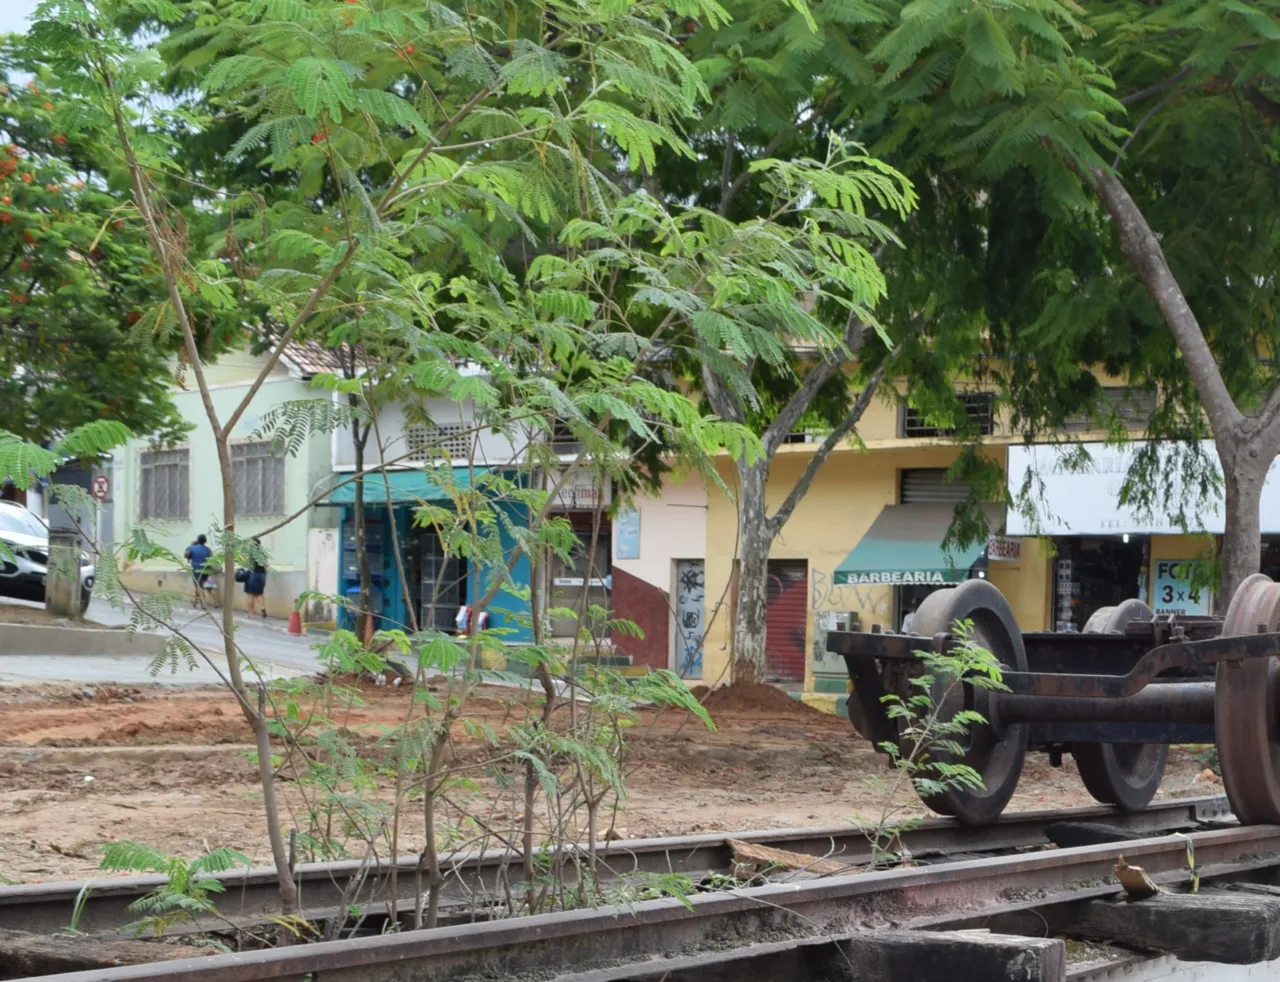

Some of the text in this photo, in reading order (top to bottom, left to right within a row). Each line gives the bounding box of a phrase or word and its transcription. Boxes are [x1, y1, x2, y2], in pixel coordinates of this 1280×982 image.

[848, 571, 944, 583] BARBEARIA
[1162, 585, 1174, 604] 3
[1188, 587, 1200, 604] 4
[1156, 608, 1185, 616] BANNER
